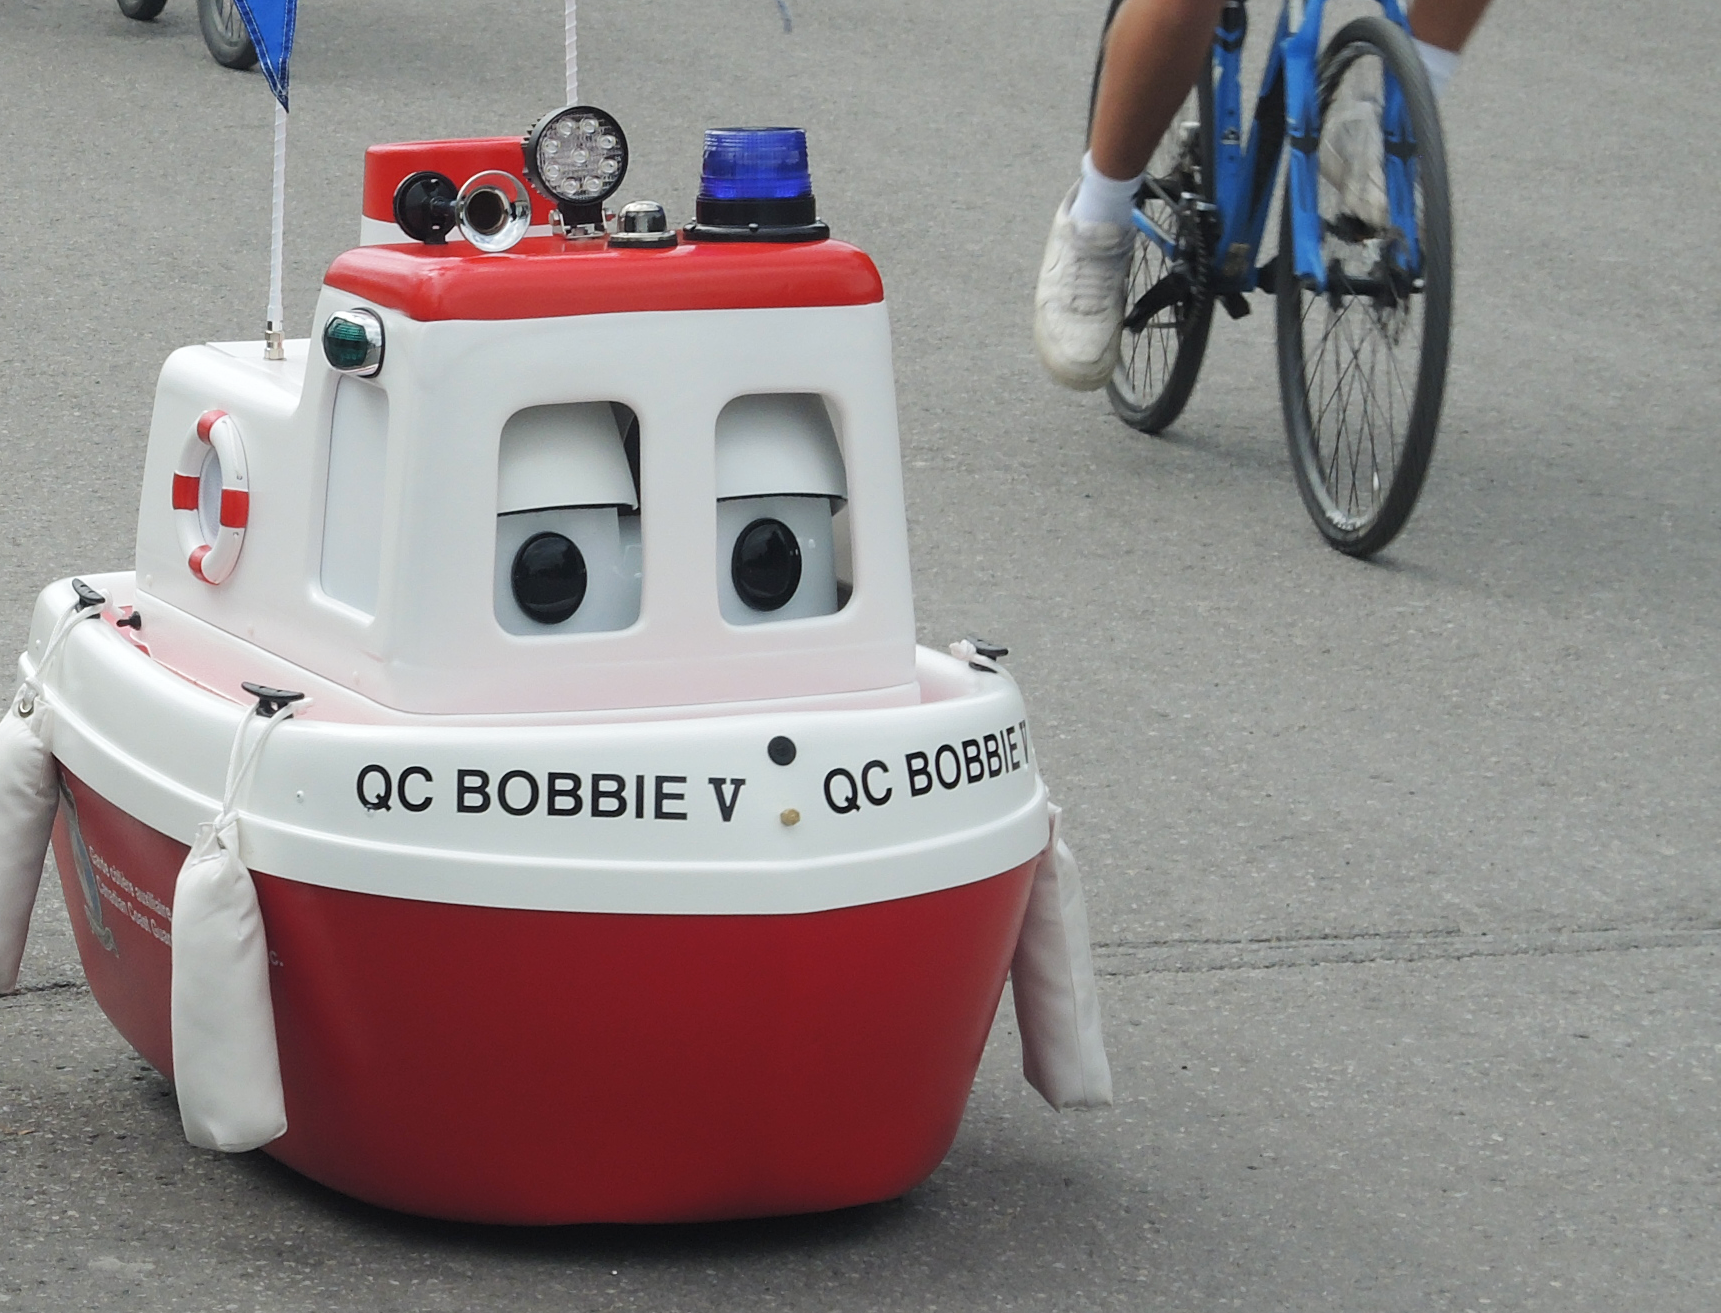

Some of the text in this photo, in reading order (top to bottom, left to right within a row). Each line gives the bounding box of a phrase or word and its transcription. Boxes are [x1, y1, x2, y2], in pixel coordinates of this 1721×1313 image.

[356, 764, 746, 823] QC BOBBIE V
[819, 758, 894, 815] QC
[904, 725, 1021, 798] BOBBIE
